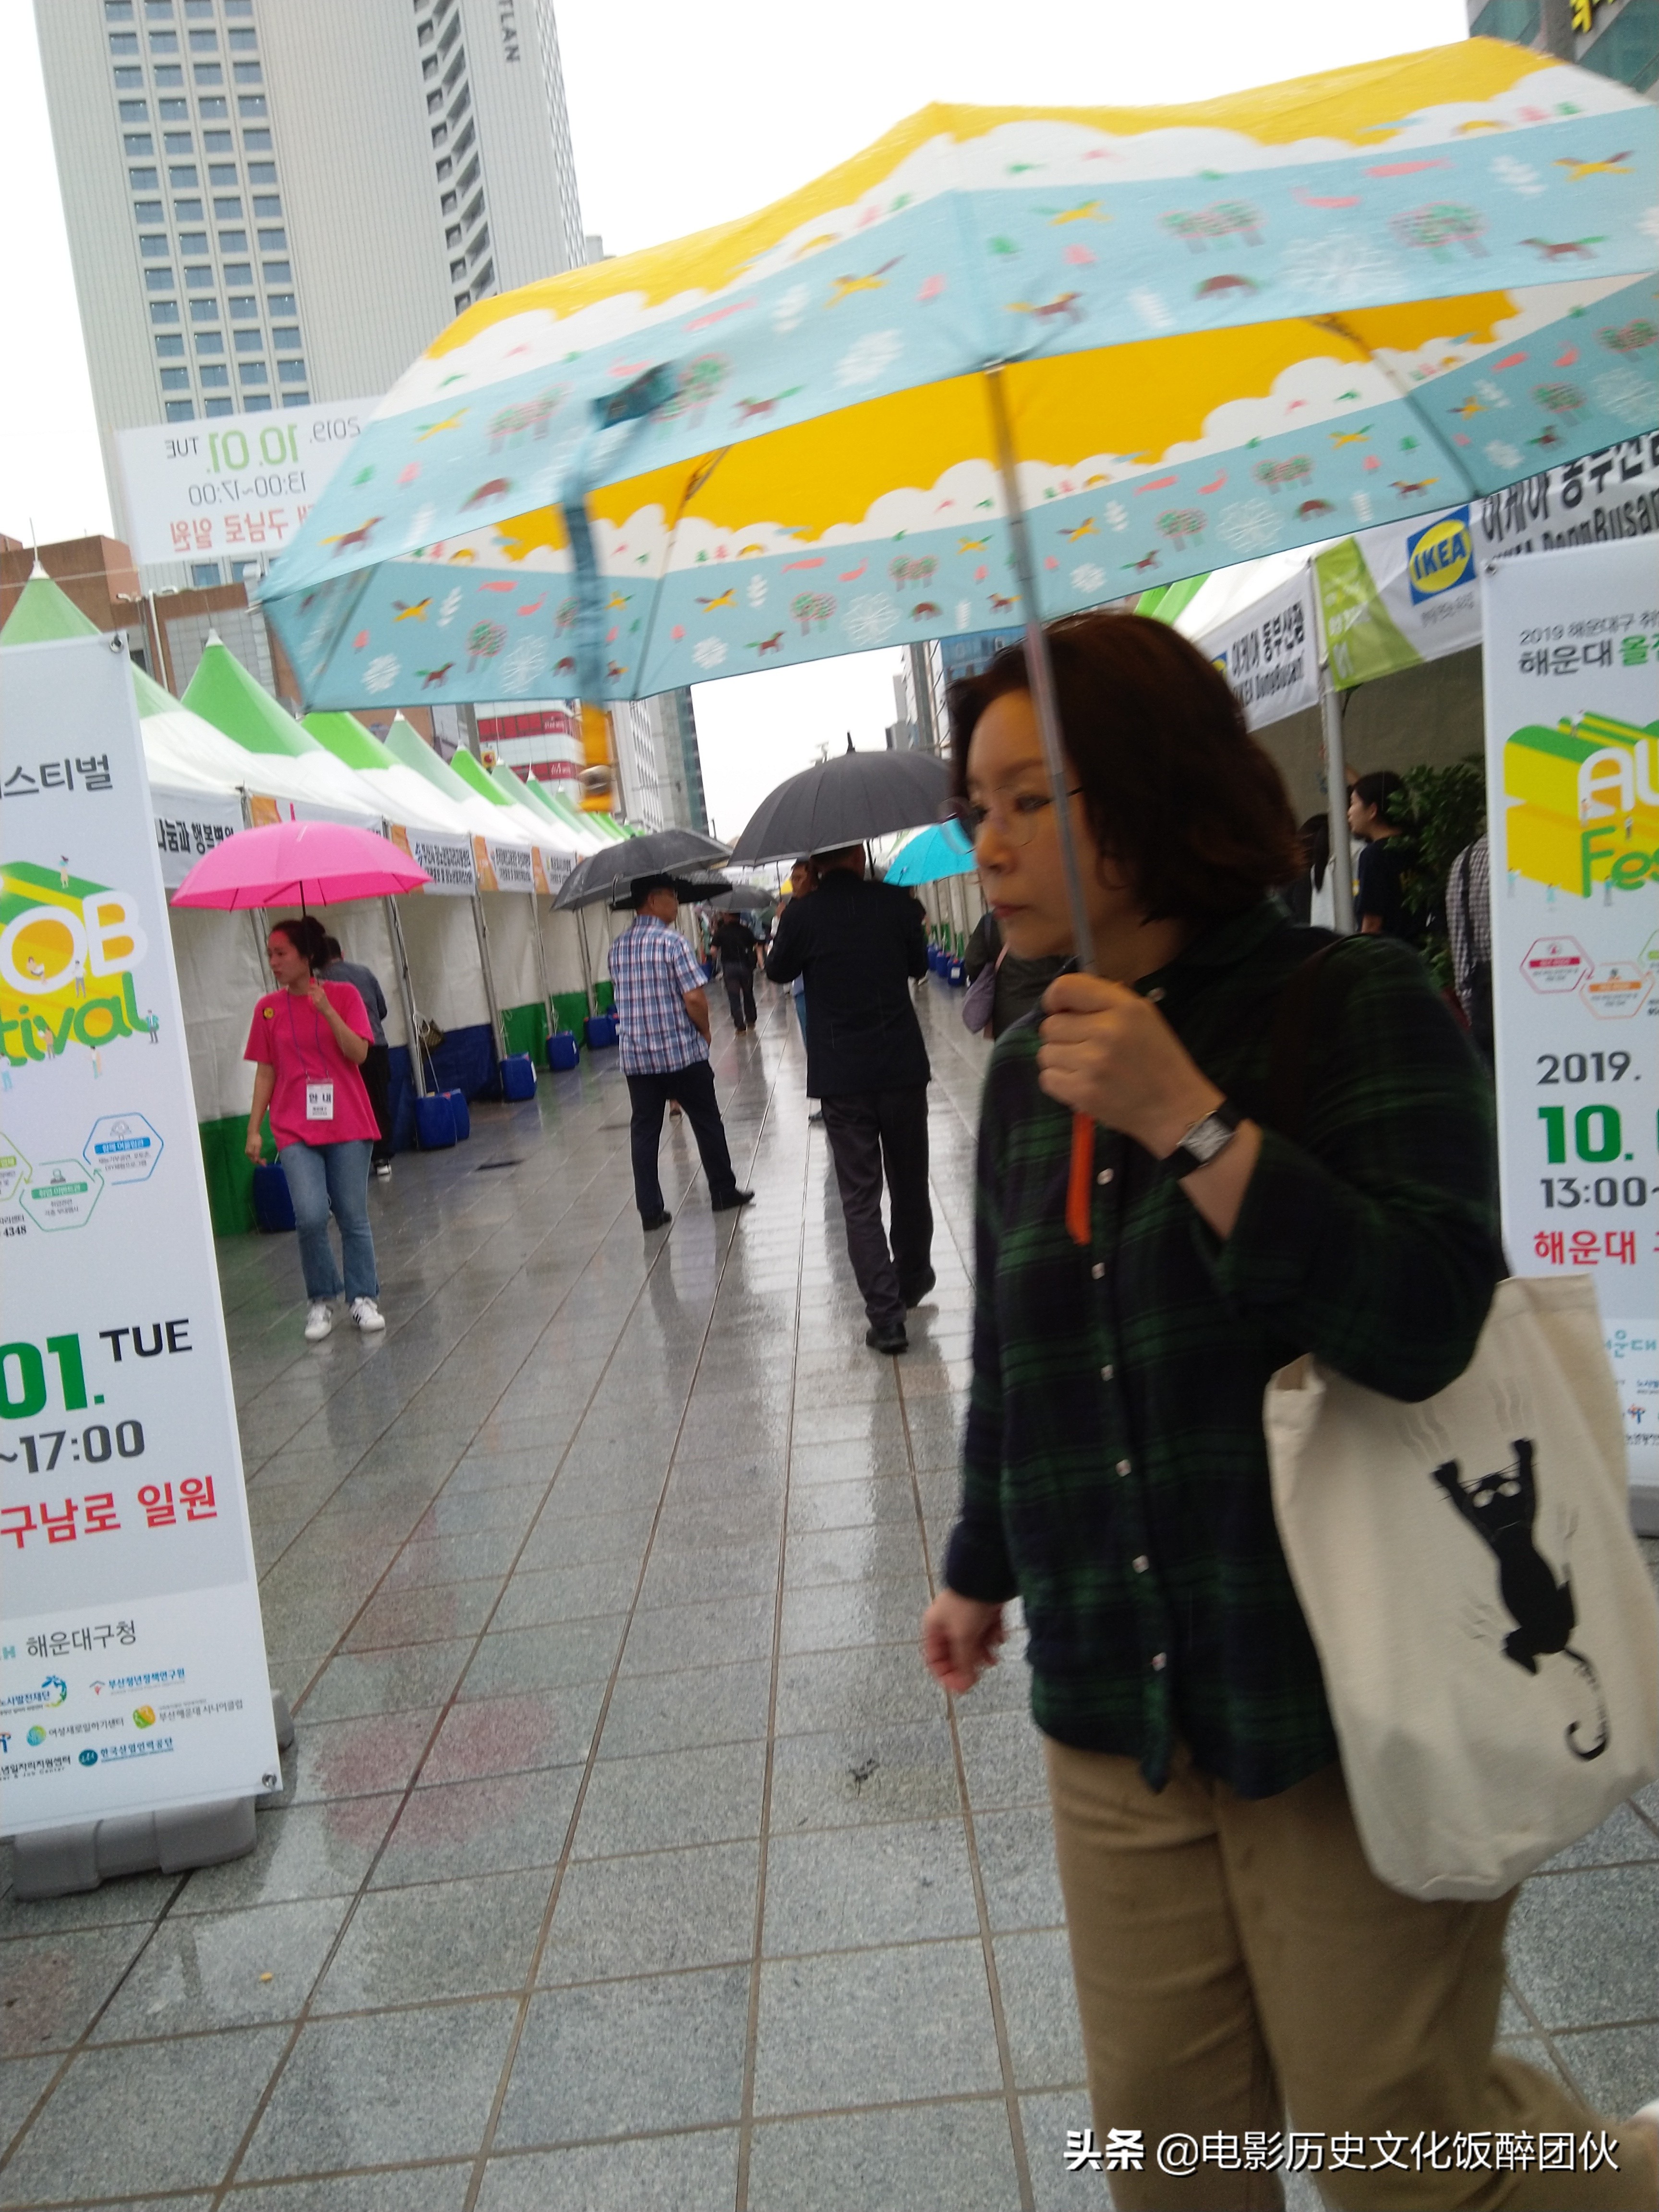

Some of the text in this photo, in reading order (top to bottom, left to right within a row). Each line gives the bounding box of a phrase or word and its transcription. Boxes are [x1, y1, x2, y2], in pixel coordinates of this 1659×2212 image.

[1413, 531, 1467, 581] IKEA
[1518, 633, 1659, 677] 해운대 올
[0, 753, 113, 799] 스티벌
[1581, 825, 1659, 899] Fe
[1537, 1051, 1642, 1085] 2019.
[1538, 1105, 1634, 1164] 10.
[1534, 1230, 1636, 1265] 해운대
[0, 1319, 192, 1419] 01. TUE
[0, 1475, 217, 1549] 구남로 일원
[26, 1620, 137, 1659] 해운대구청
[100, 1736, 173, 1758] 한국산업인력공단
